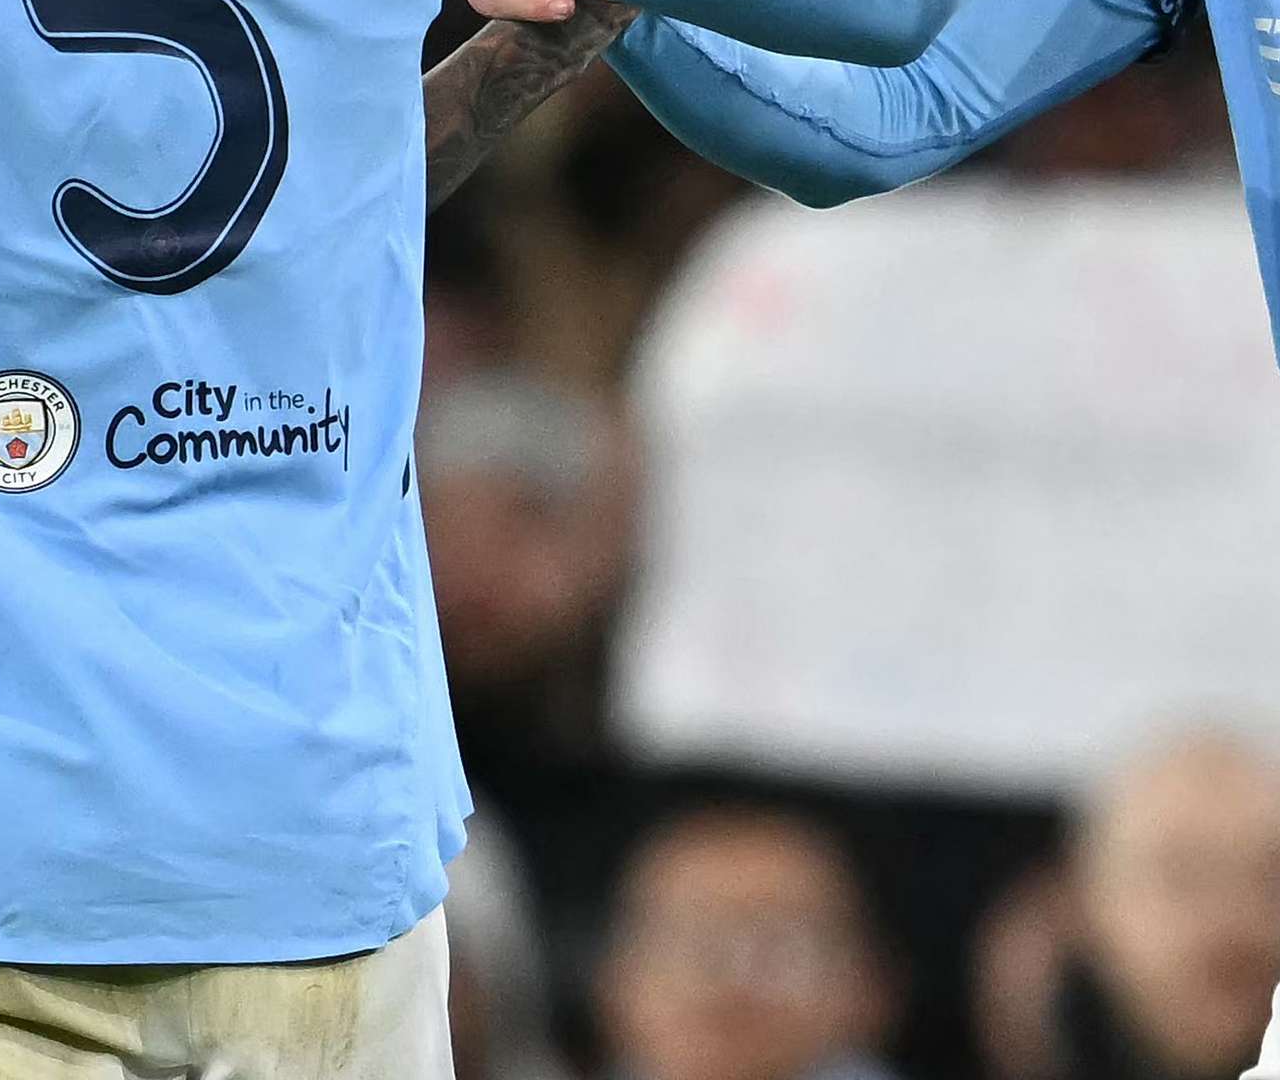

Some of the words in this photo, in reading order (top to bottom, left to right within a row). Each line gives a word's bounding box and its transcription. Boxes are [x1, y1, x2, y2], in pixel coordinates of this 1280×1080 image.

[152, 379, 237, 421] City
[244, 392, 262, 411] in
[270, 390, 304, 410] the
[106, 387, 350, 472] Community
[2, 471, 38, 484] CITY
